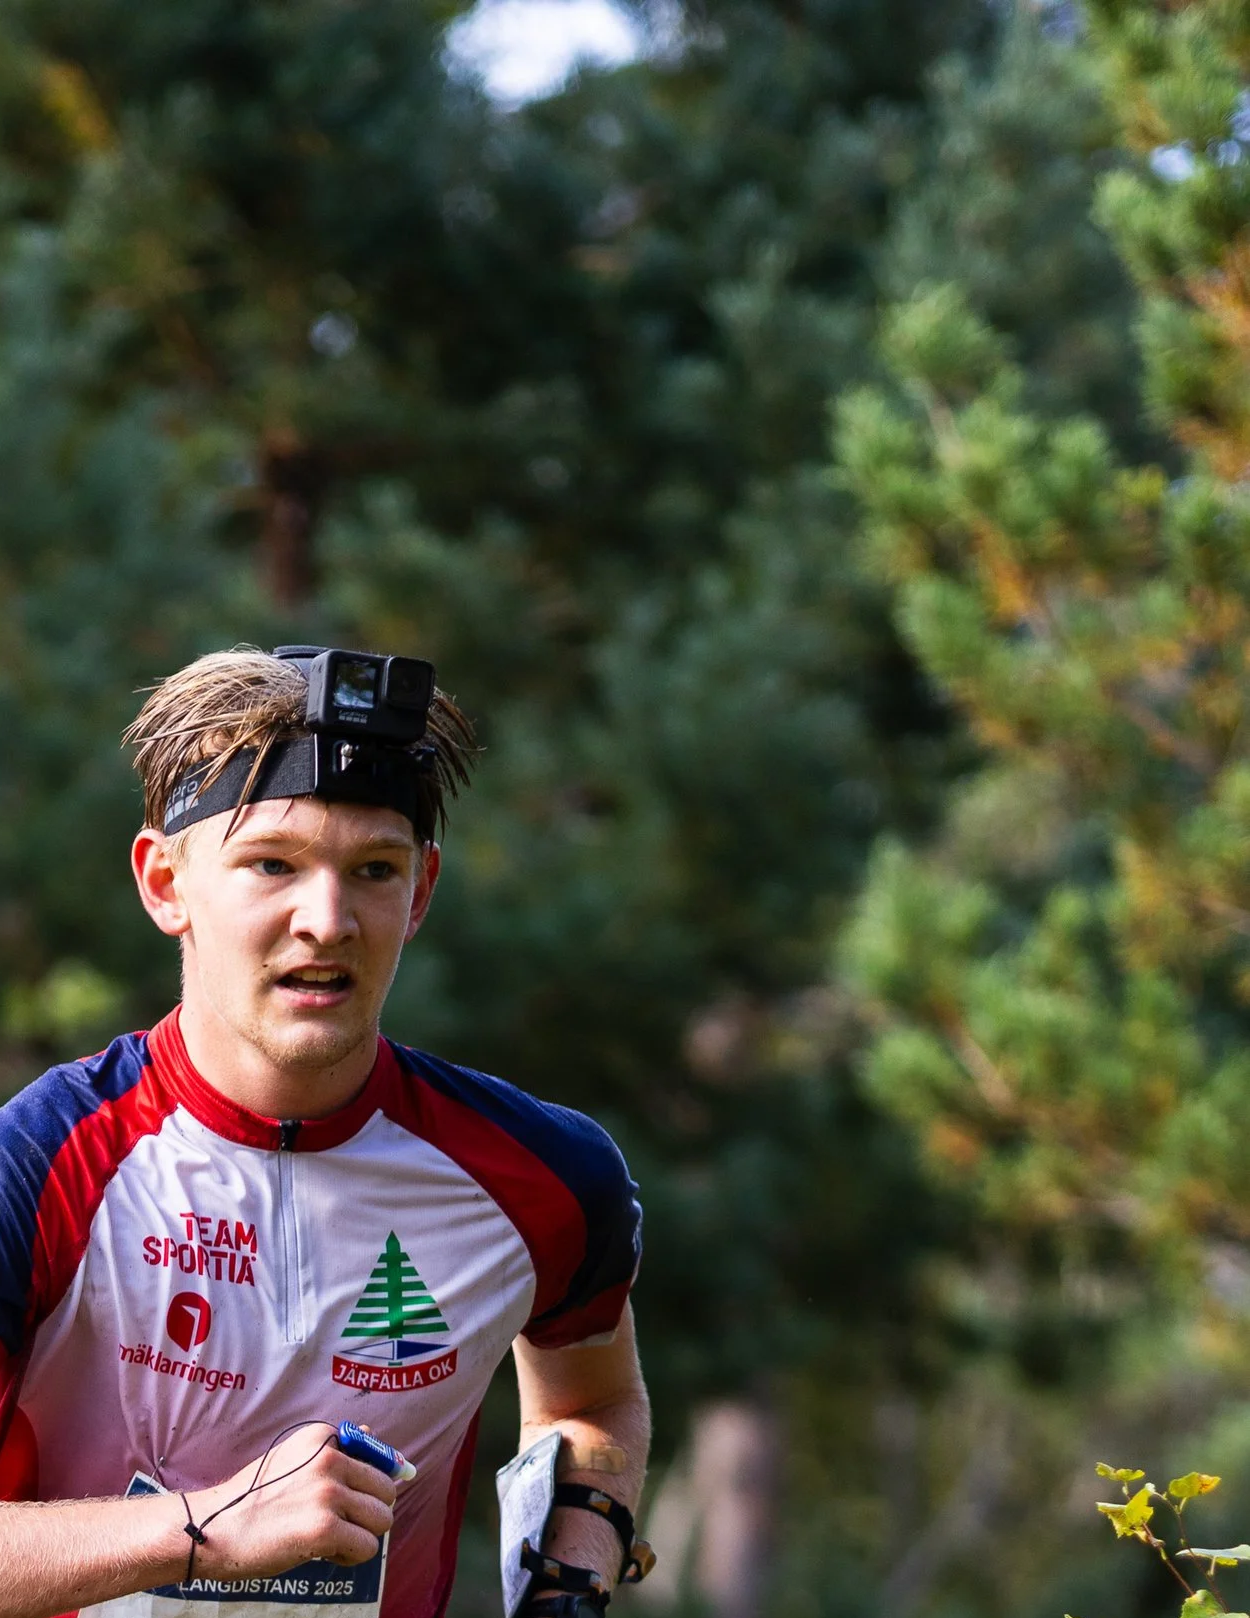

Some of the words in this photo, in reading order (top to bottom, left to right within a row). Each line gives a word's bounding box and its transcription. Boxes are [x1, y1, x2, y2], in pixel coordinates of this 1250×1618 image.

[180, 1212, 258, 1254] TEAM
[142, 1236, 257, 1287] SPORTIA
[119, 1343, 246, 1392] mäklarringen
[334, 1363, 424, 1390] JÄRFÄLLA
[428, 1358, 453, 1381] OK
[313, 1581, 354, 1596] 2025
